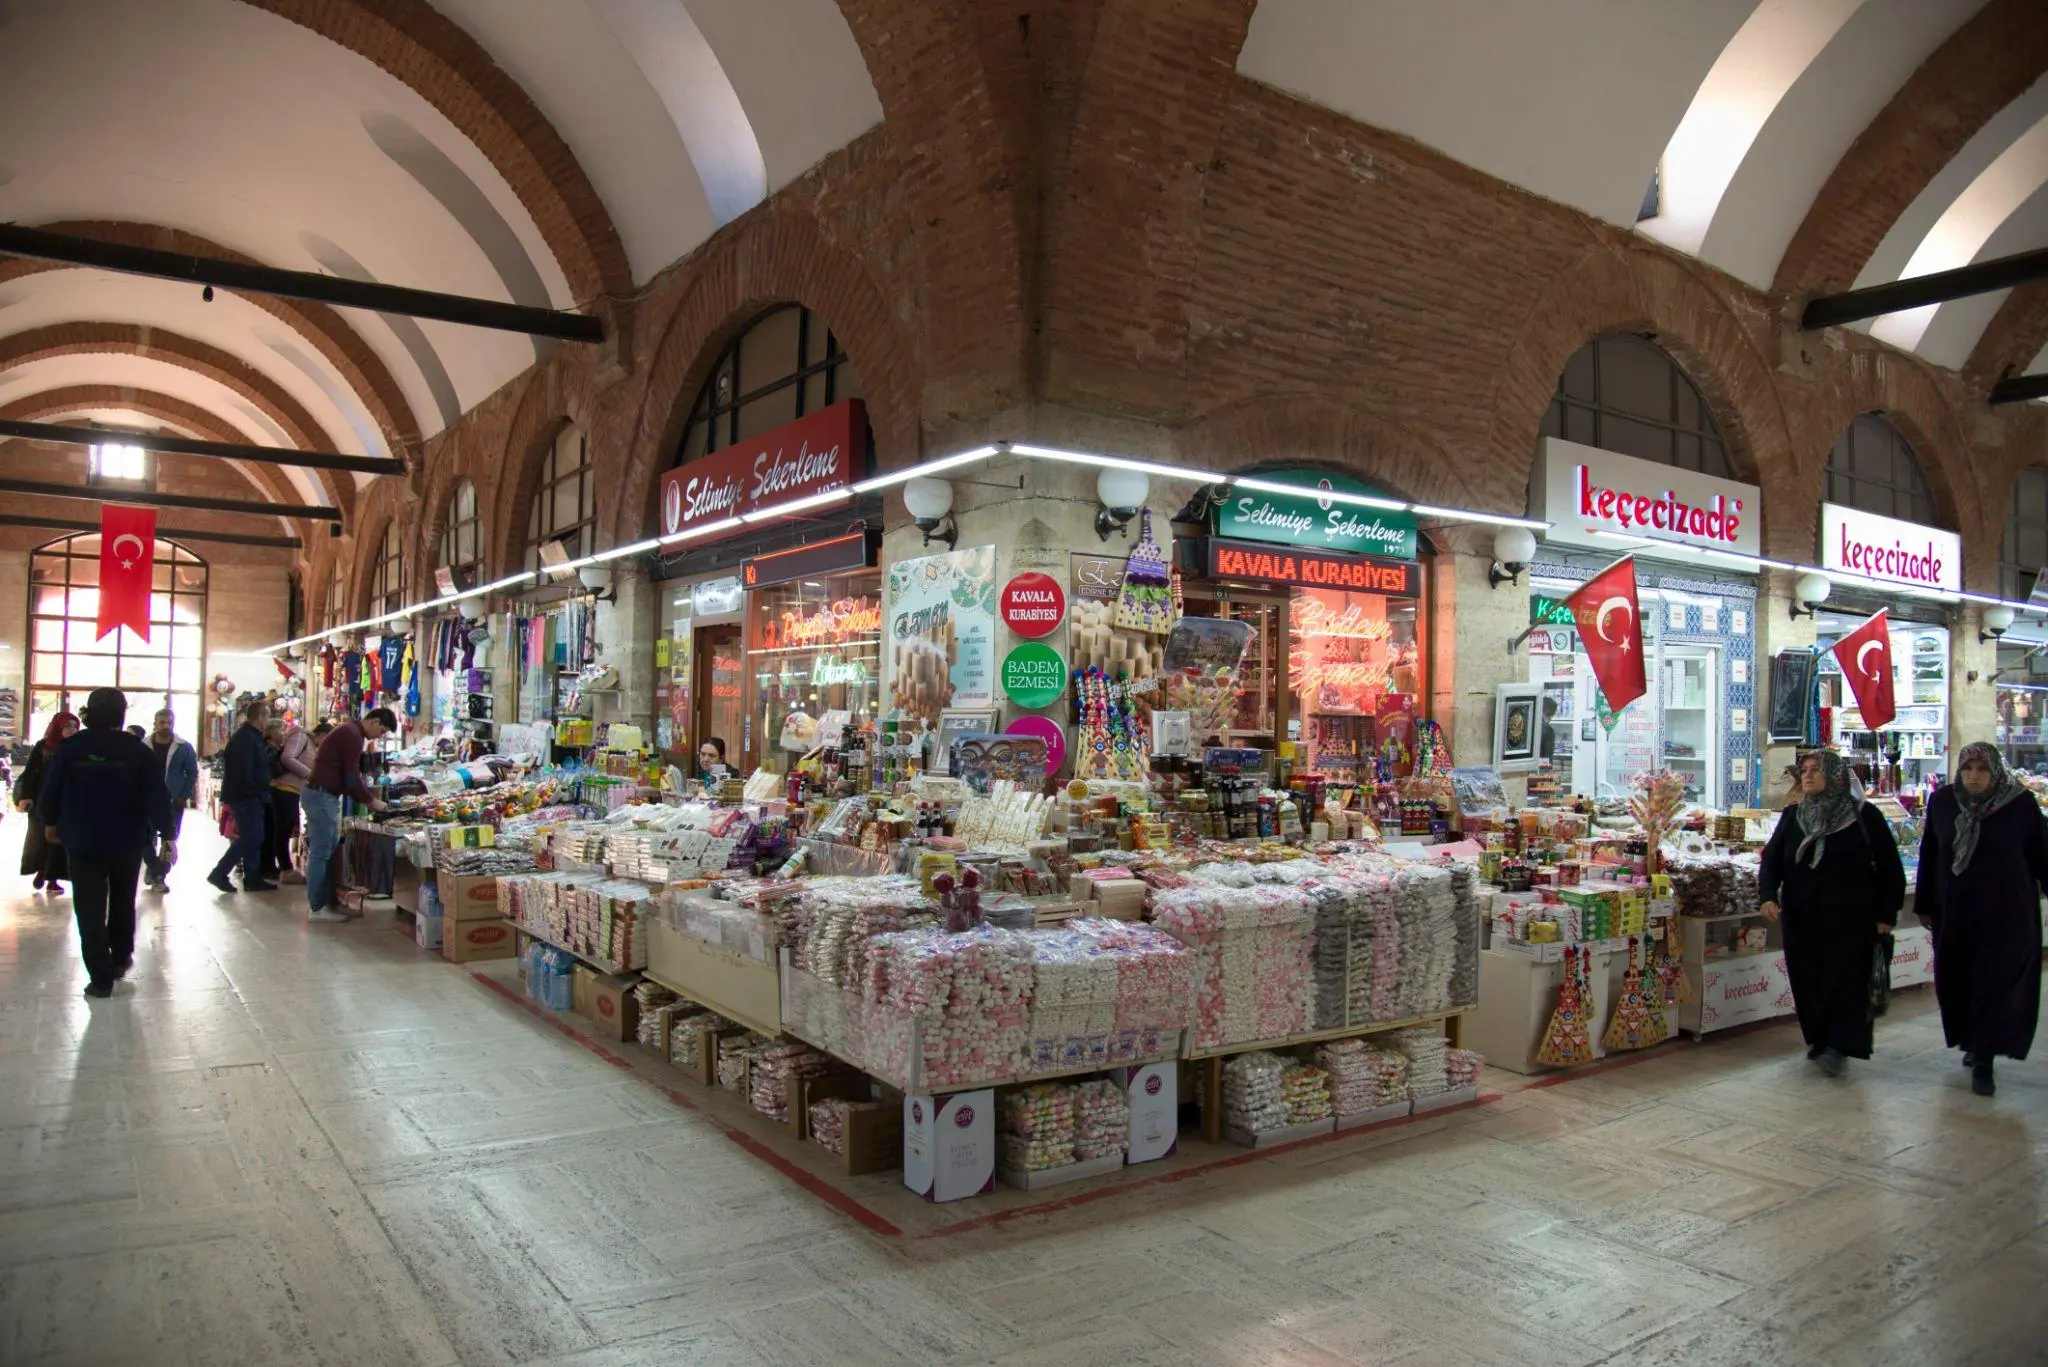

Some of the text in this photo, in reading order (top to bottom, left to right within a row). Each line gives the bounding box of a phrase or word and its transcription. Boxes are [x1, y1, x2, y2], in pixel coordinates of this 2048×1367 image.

[683, 474, 746, 521] Selimiye
[1577, 464, 1743, 542] keçecizade
[1234, 497, 1406, 543] Selimiye Şekerleme
[1383, 543, 1406, 554] 1973
[1841, 522, 1943, 584] keçecizade
[1218, 549, 1407, 591] KAVALA KURABİYESİ
[1011, 590, 1055, 603] KAVALA
[1008, 606, 1058, 621] KURABİYESİ
[386, 651, 398, 669] 17
[1007, 660, 1060, 674] BADEM
[1007, 675, 1060, 689] EZMESİ
